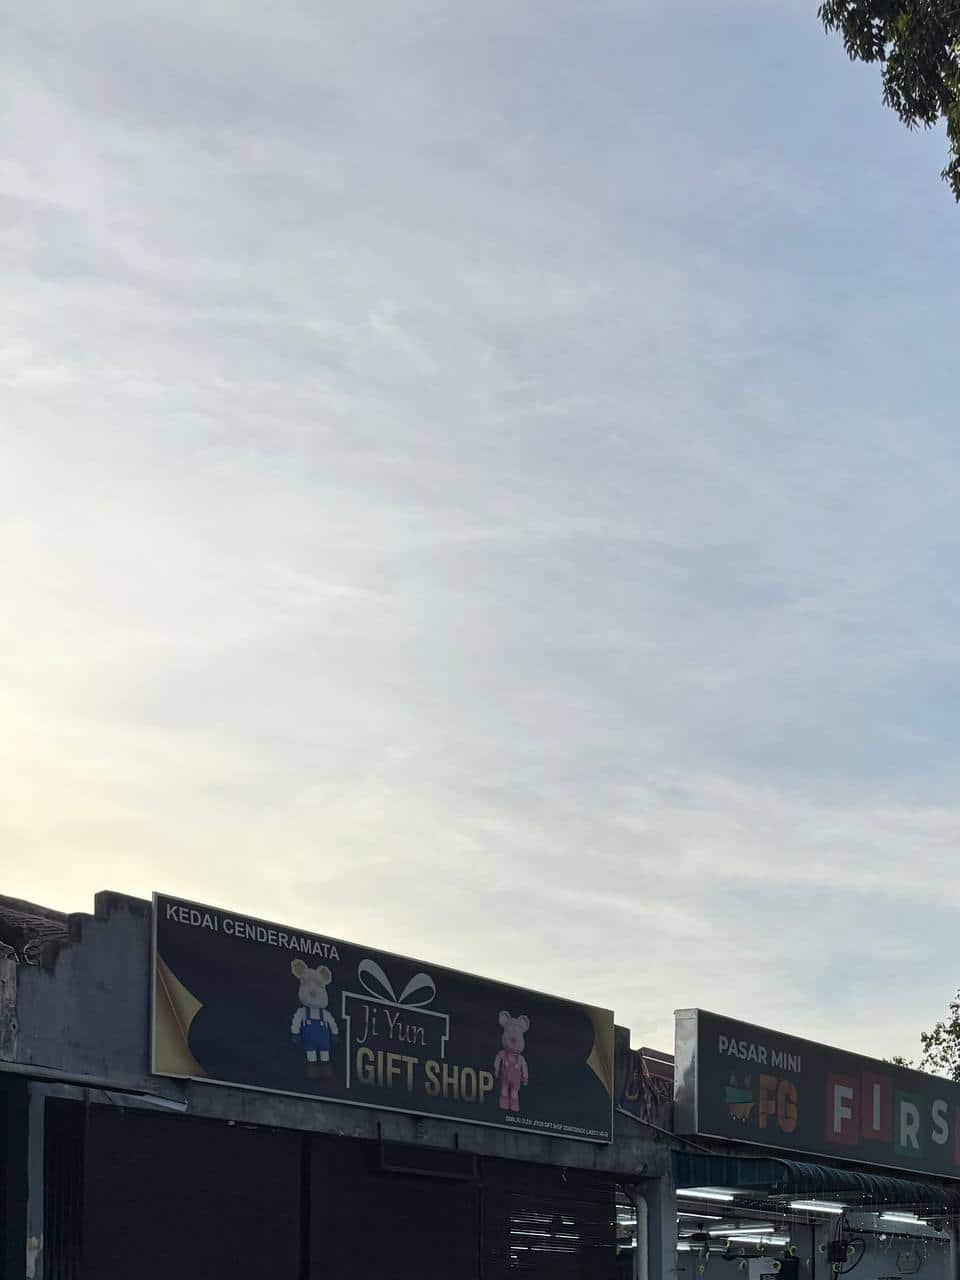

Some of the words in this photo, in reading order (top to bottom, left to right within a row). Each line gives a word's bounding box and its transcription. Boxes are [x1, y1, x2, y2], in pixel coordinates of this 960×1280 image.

[166, 903, 218, 931] KEDAI
[222, 917, 341, 961] CENDERAMATA
[356, 1003, 378, 1046] Ji
[383, 1009, 428, 1047] Yun
[356, 1046, 419, 1092] GIFT
[424, 1059, 495, 1102] SHOP
[718, 1034, 768, 1066] PASAR
[771, 1049, 801, 1073] MINI
[756, 1072, 798, 1133] FG
